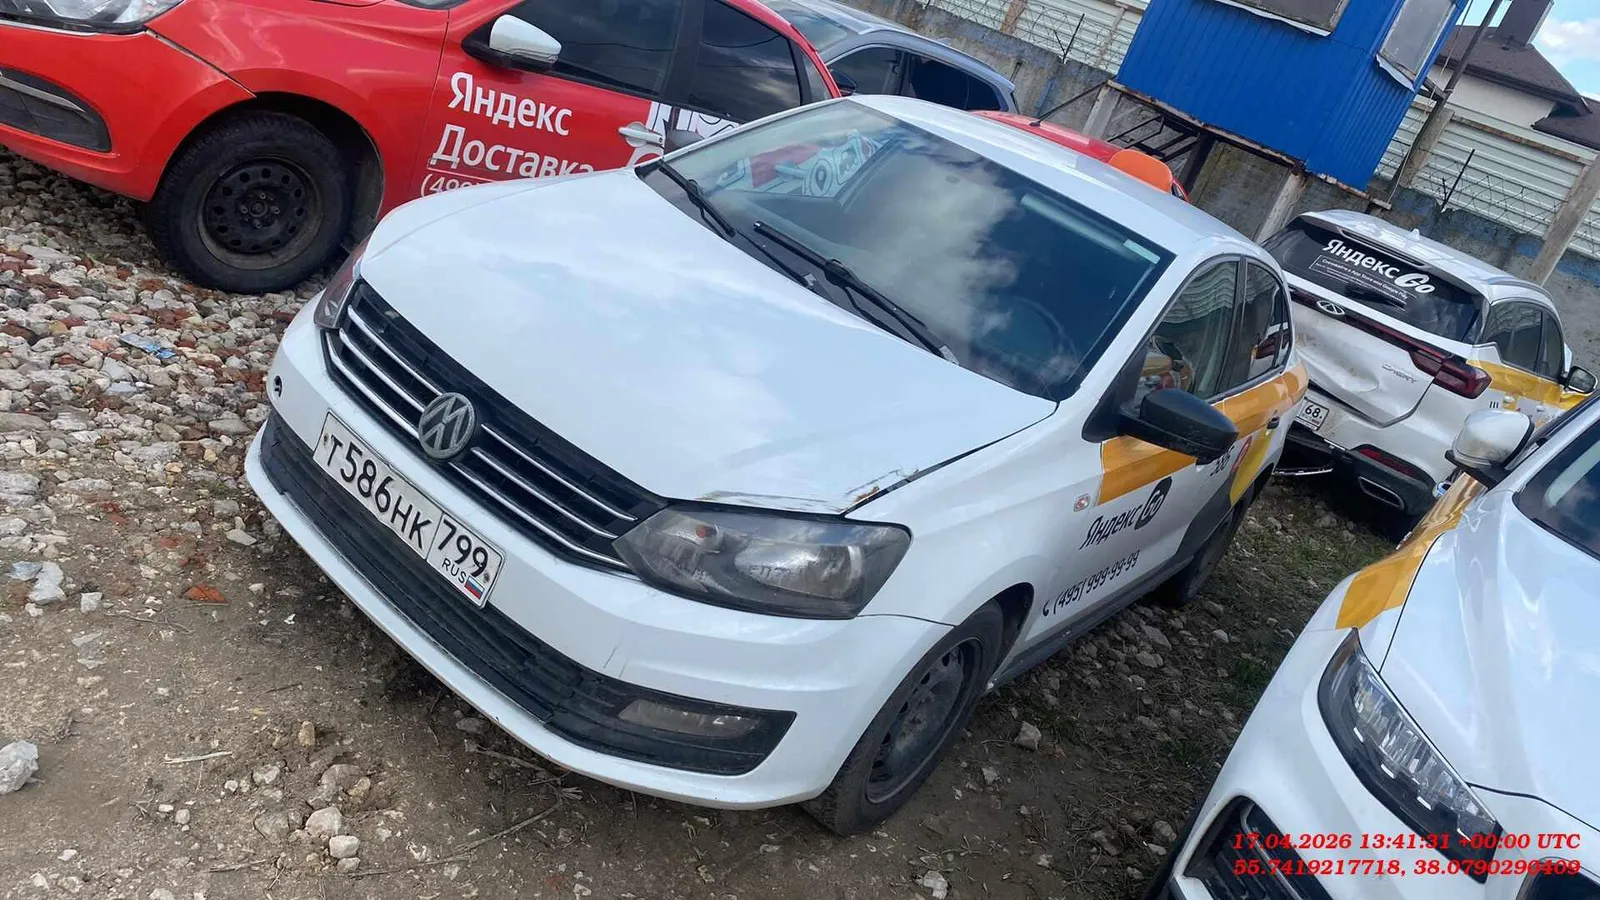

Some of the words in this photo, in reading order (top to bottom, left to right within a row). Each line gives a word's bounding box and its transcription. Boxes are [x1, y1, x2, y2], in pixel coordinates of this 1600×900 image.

[447, 72, 573, 137] Яндекс
[1322, 239, 1400, 279] Яндекс
[1394, 272, 1436, 294] Go
[1305, 404, 1321, 418] 68
[325, 434, 432, 549] Т586НК
[437, 519, 489, 577] 799
[1078, 504, 1143, 550] Яндекс
[442, 557, 467, 584] RUS
[1053, 579, 1087, 614] (495)
[1086, 549, 1140, 594] 999-99-99
